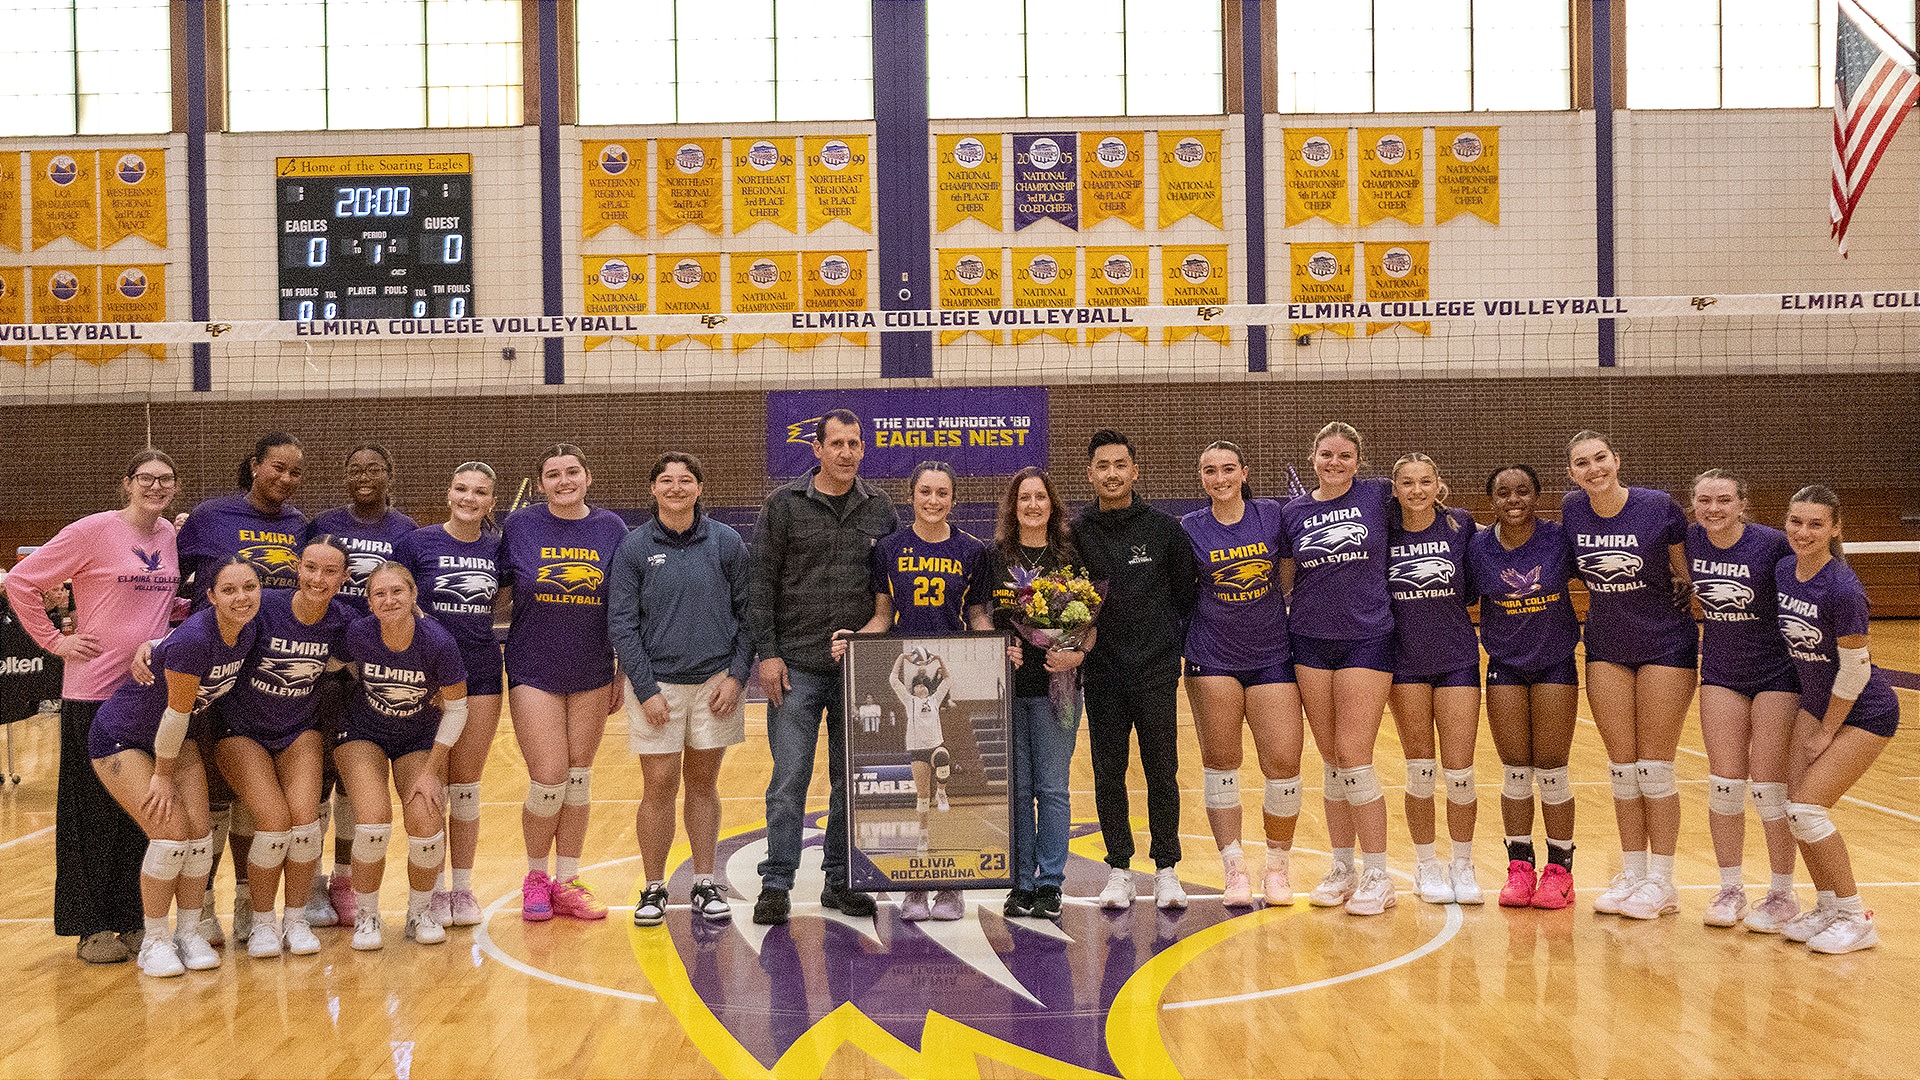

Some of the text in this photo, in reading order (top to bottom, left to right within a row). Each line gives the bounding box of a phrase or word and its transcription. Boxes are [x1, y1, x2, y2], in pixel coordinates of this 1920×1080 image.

[736, 154, 793, 167] 19 98
[808, 154, 866, 166] 19 99
[942, 153, 998, 164] 20 04
[1018, 153, 1072, 164] 20 05
[1085, 151, 1140, 162] 20 05
[1163, 152, 1217, 162] 20 07
[1290, 150, 1344, 161] 20 13
[1363, 150, 1420, 161] 20 15
[301, 157, 463, 173] Home of the Soaring Eagles
[1447, 165, 1491, 174] NATIONAL
[948, 171, 992, 180] NATIONAL
[1023, 172, 1067, 180] NATIONAL
[1090, 170, 1134, 179] NATIONAL
[1295, 170, 1340, 178] NATIONAL
[1370, 169, 1415, 178] NATIONAL
[666, 178, 715, 186] NORTHEAST
[738, 175, 790, 184] NORTHEAST
[810, 174, 863, 184] NORTHEAST
[1439, 176, 1498, 184] CHAMPIONSHIP
[814, 185, 860, 194] REGIONAL
[940, 182, 1000, 191] CHAMPIONSHIP
[1016, 182, 1076, 192] CHAMPIONSHIP
[1083, 180, 1142, 190] CHAMPIONSHIP
[1169, 181, 1214, 190] NATIONAL
[1289, 180, 1345, 189] CHAMPIONSHIP
[1362, 180, 1419, 189] CHAMPIONSHIP
[742, 186, 787, 195] REGIONAL
[964, 193, 989, 201] PLACE
[1027, 193, 1065, 202] 3rd PLACE
[1167, 192, 1216, 200] CHAMPIONS
[1455, 197, 1483, 205] CHEER
[336, 187, 411, 217] 20:00
[758, 197, 784, 206] PLACE
[1099, 202, 1127, 211] CHEER
[1304, 201, 1332, 209] CHEER
[1378, 201, 1407, 209] CHEER
[750, 208, 779, 217] CHEER
[822, 207, 852, 216] CHEER
[957, 203, 984, 212] CHEER
[1019, 203, 1073, 213] CO-ED CHEER
[286, 220, 328, 232] EAGLES
[425, 217, 460, 229] GUEST
[363, 231, 387, 239] PERIOD
[308, 237, 328, 267] 0
[373, 244, 382, 265] 1
[443, 235, 463, 264] 0
[944, 270, 998, 281] 20 08
[1017, 269, 1072, 280] 20 09
[1090, 268, 1144, 279] 20 11
[1169, 268, 1223, 278] 20 12
[1296, 265, 1350, 276] 20 14
[1371, 265, 1425, 277] 20 16
[587, 274, 644, 285] 19 99
[660, 273, 716, 284] 20 00
[736, 272, 792, 284] 20 02
[808, 270, 862, 282] 20 03
[433, 284, 470, 293] TM FOULS
[1302, 284, 1346, 293] NATIONAL
[1376, 279, 1419, 288] NATIONAL
[282, 288, 319, 297] TM FOULS
[325, 291, 337, 299] TOL
[348, 286, 408, 295] PLAYER FOULS
[415, 289, 427, 297] TOL
[814, 288, 856, 297] NATIONAL
[950, 288, 994, 296] NATIONAL
[1023, 288, 1067, 296] NATIONAL
[1096, 287, 1142, 296] NATIONAL
[1174, 287, 1220, 296] NATIONAL
[1369, 289, 1426, 298] CHAMPIONSHIP
[592, 293, 640, 302] NATIONAL
[742, 293, 788, 301] NATIONAL
[1088, 297, 1147, 306] CHAMPIONSHIP
[1167, 297, 1226, 306] CHAMPIONSHIP
[1781, 293, 1863, 309] ELMIRA
[665, 302, 712, 310] NATIONAL
[736, 302, 795, 312] CHAMPIONSHIP
[806, 299, 863, 308] CHAMPIONSHIP
[942, 298, 1000, 307] CHAMPIONSHIP
[1016, 298, 1073, 307] CHAMPIONSHIP
[298, 300, 314, 322] 0
[324, 302, 337, 319] 0
[414, 301, 426, 317] 0
[450, 297, 465, 319] 0
[1288, 297, 1629, 319] ELMIRA COLLEGE VOLLEYBALL
[792, 307, 1133, 328] ELMIRA COLLEGE VOLLEYBALL
[297, 315, 637, 336] ELMIRA COLLEGE VOLLEYBALL
[0, 324, 142, 340] VOLLEYBALL
[874, 416, 1030, 429] THE DOC MURDOCK '80
[876, 429, 1029, 447] EAGLES NEST
[1303, 507, 1362, 529] ELMIRA
[239, 530, 297, 546] ELMIRA
[1578, 534, 1638, 548] ELMIRA
[1210, 542, 1268, 562] ELMIRA
[1390, 541, 1450, 557] ELMIRA
[541, 548, 600, 561] ELMIRA
[1301, 551, 1369, 568] VOLLEYBALL
[440, 556, 496, 571] ELMIRA
[898, 556, 962, 575] ELMIRA
[1693, 559, 1750, 578] ELMIRA
[913, 577, 946, 607] 23
[535, 593, 602, 605] VOLLEYBALL
[433, 601, 492, 614] VOLLEYBALL
[270, 637, 328, 656] ELMIRA
[364, 662, 426, 682] ELMIRA
[910, 857, 955, 868] OLIVIA
[979, 854, 1005, 871] 23
[891, 868, 975, 879] ROCCABRUNA
